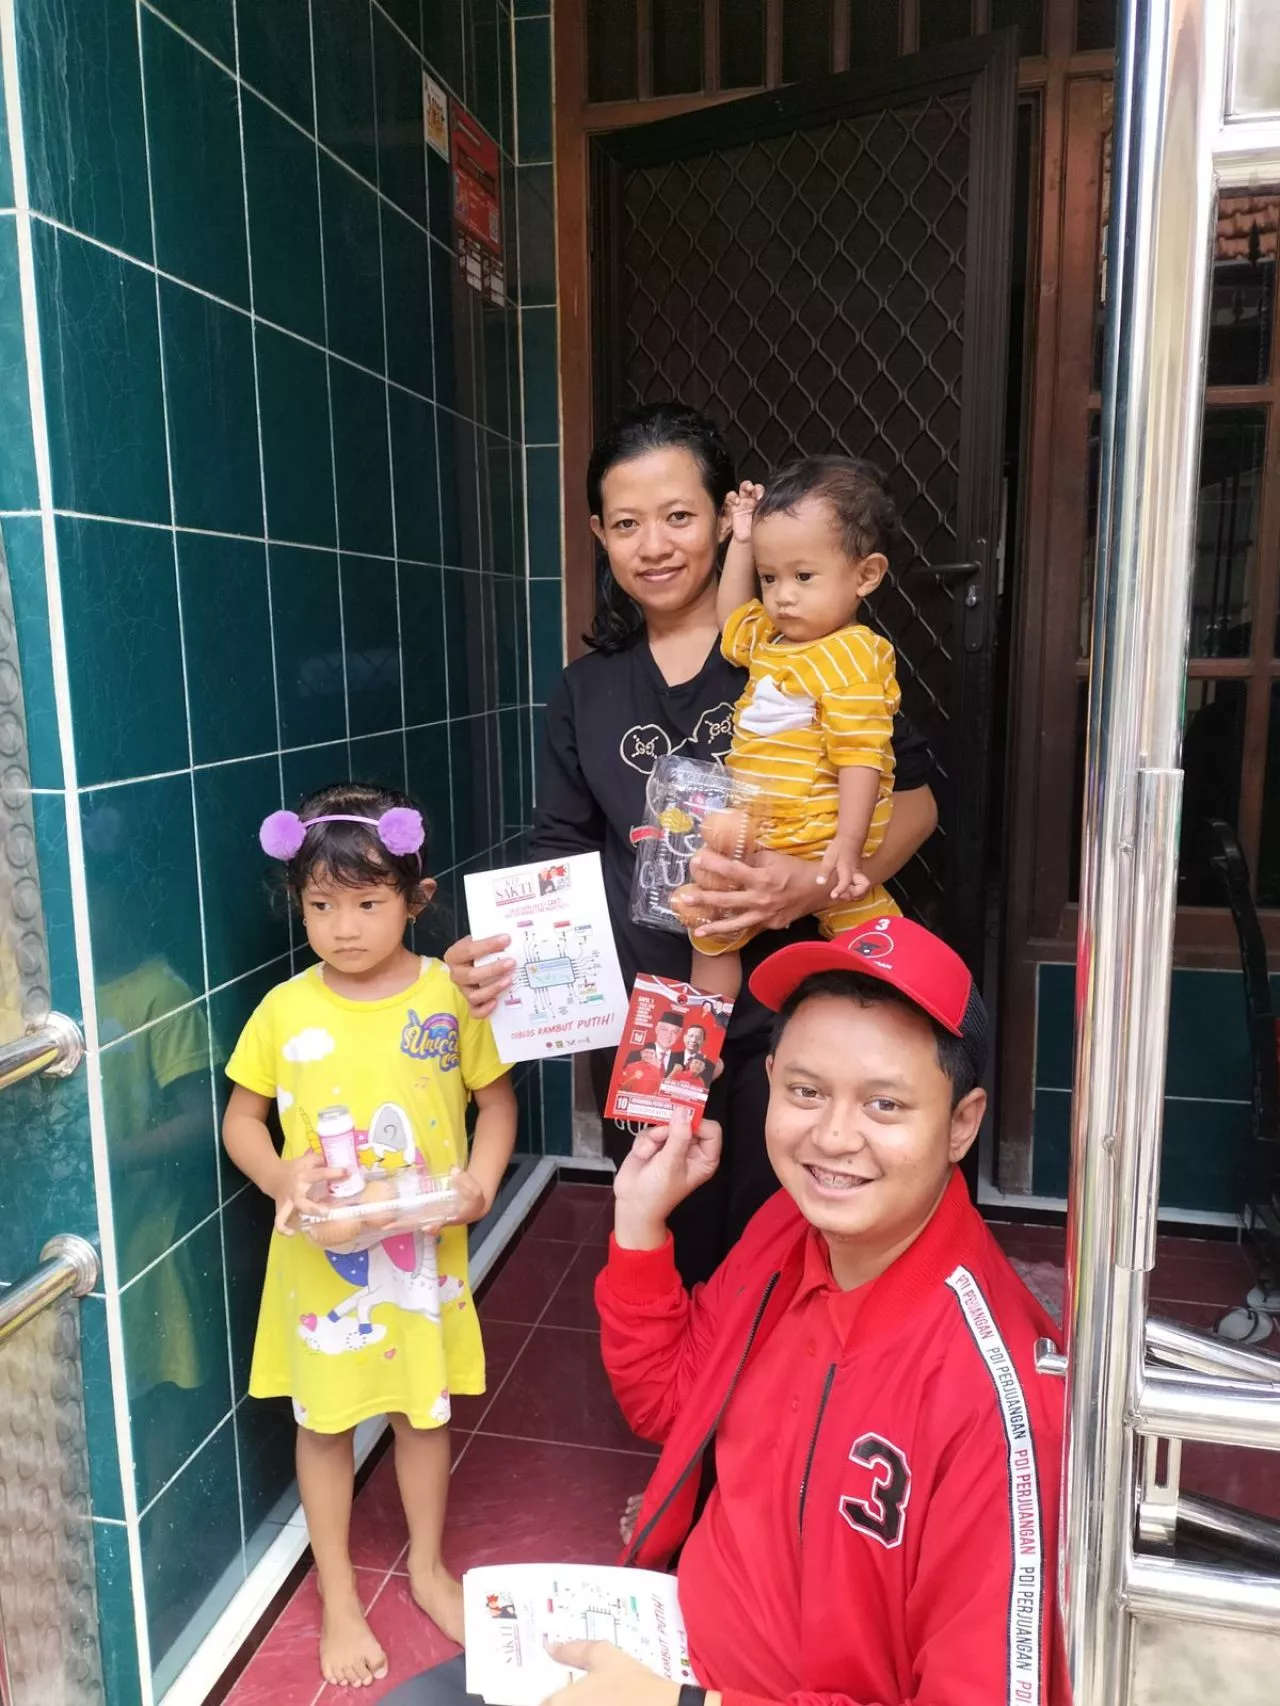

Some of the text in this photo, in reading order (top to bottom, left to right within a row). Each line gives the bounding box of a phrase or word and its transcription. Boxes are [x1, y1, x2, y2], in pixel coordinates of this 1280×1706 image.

[875, 918, 890, 931] 3
[538, 1020, 573, 1035] RAMBUT
[988, 1346, 1004, 1366] PDI
[998, 1366, 1027, 1440] PERJUANGAN
[1014, 1449, 1030, 1471] PDI
[839, 1432, 911, 1550] 3
[1016, 1473, 1036, 1555] PERJUANGAN
[1018, 1567, 1035, 1587] PDI
[1015, 1591, 1034, 1671] PERJUANGAN
[1015, 1680, 1032, 1703] PDI
